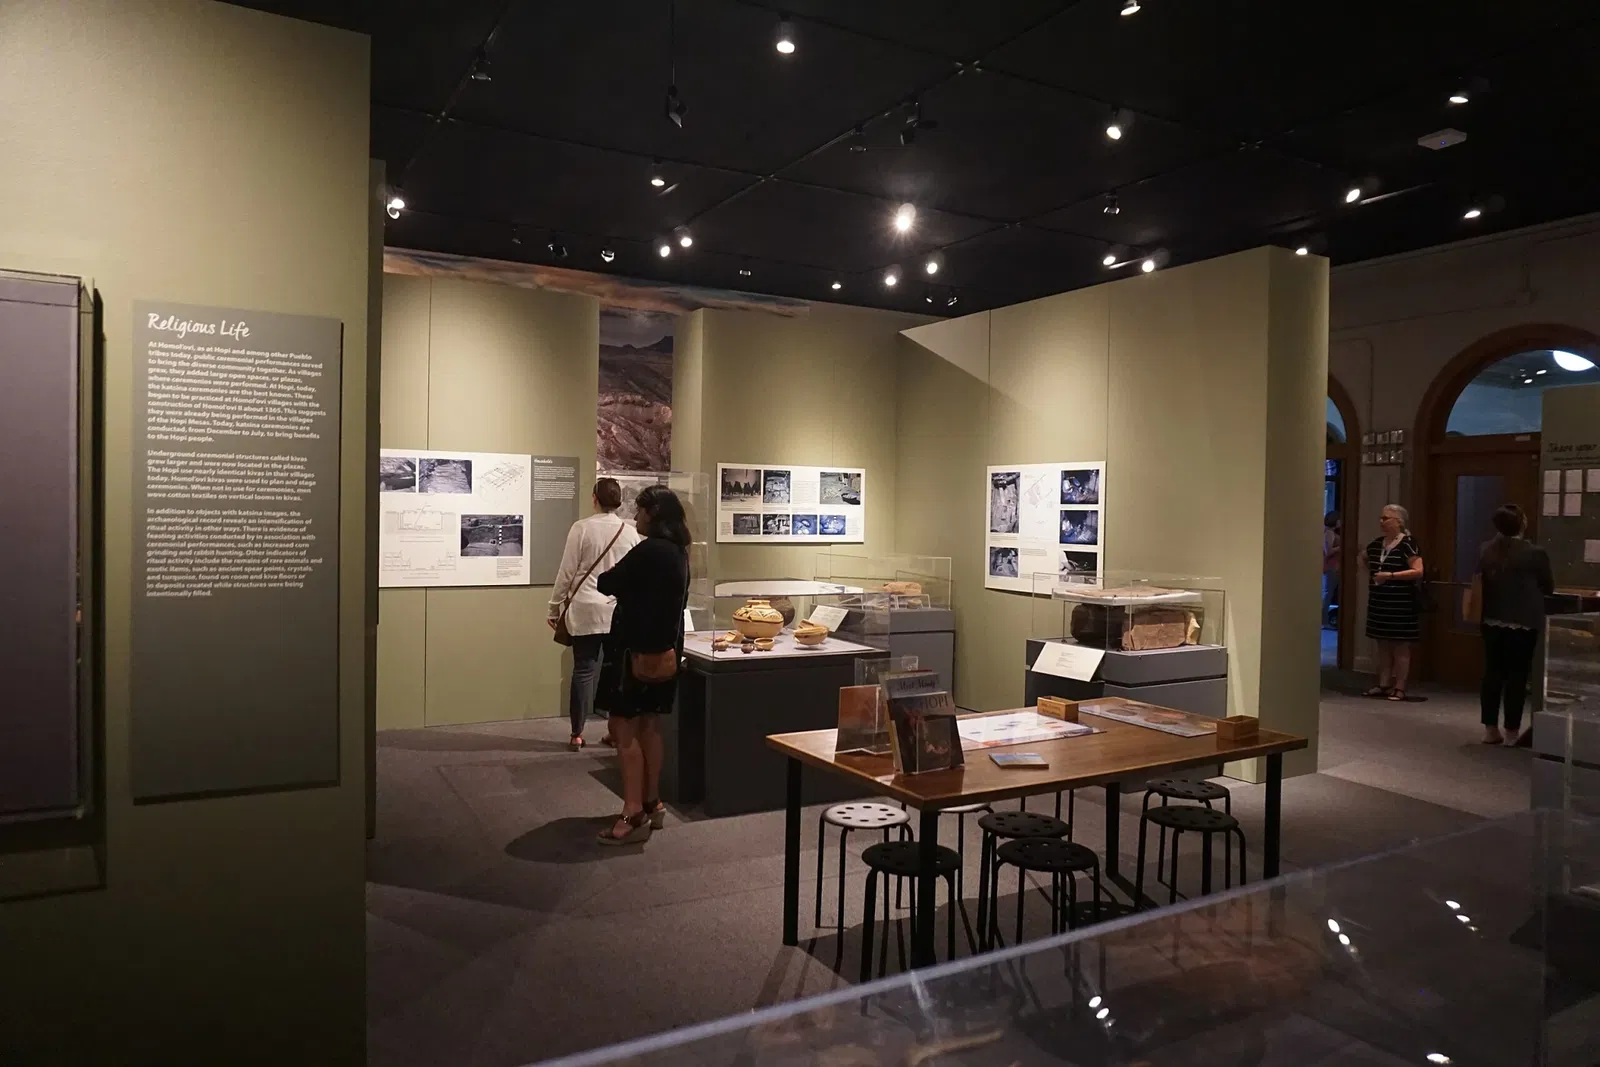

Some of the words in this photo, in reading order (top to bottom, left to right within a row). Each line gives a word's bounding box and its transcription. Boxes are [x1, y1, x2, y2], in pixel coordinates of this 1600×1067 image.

[147, 313, 216, 339] Religious
[219, 319, 250, 341] Life
[148, 349, 169, 358] tribes
[194, 353, 215, 363] public
[216, 354, 253, 364] ceremonial
[255, 357, 300, 369] performances
[302, 360, 323, 369] served
[214, 346, 230, 356] Hopi
[246, 350, 269, 358] among
[271, 350, 288, 358] other
[290, 351, 312, 360] Pueblo
[158, 358, 176, 368] bring
[192, 360, 216, 369] diverse
[218, 362, 255, 374] community
[298, 368, 322, 379] villages
[169, 367, 185, 377] they
[186, 368, 208, 377] added
[210, 370, 227, 380] large
[229, 373, 246, 381] open
[148, 374, 170, 383] where
[172, 376, 211, 385] ceremonies
[189, 385, 227, 394] ceremonies
[294, 391, 313, 399] These
[148, 391, 170, 401] began
[191, 394, 223, 404] practiced
[268, 398, 292, 408] villages
[148, 399, 192, 409] construction
[244, 405, 263, 413] about
[298, 408, 327, 418] suggests
[148, 408, 164, 417] they
[184, 409, 209, 419] already
[211, 411, 230, 420] being
[232, 412, 267, 422] performed
[289, 415, 313, 425] villages
[170, 417, 186, 426] Hopi
[262, 421, 298, 430] ceremonies
[170, 433, 187, 443] Hopi
[207, 427, 240, 436] December
[275, 430, 292, 440] bring
[294, 431, 320, 439] benefits
[148, 449, 195, 459] Underground
[197, 451, 234, 459] ceremonial
[236, 452, 269, 460] structures
[167, 458, 187, 468] larger
[162, 466, 179, 475] Hopi
[194, 467, 215, 477] nearly
[290, 470, 315, 480] villages
[270, 477, 284, 486] plan
[299, 478, 317, 487] stage
